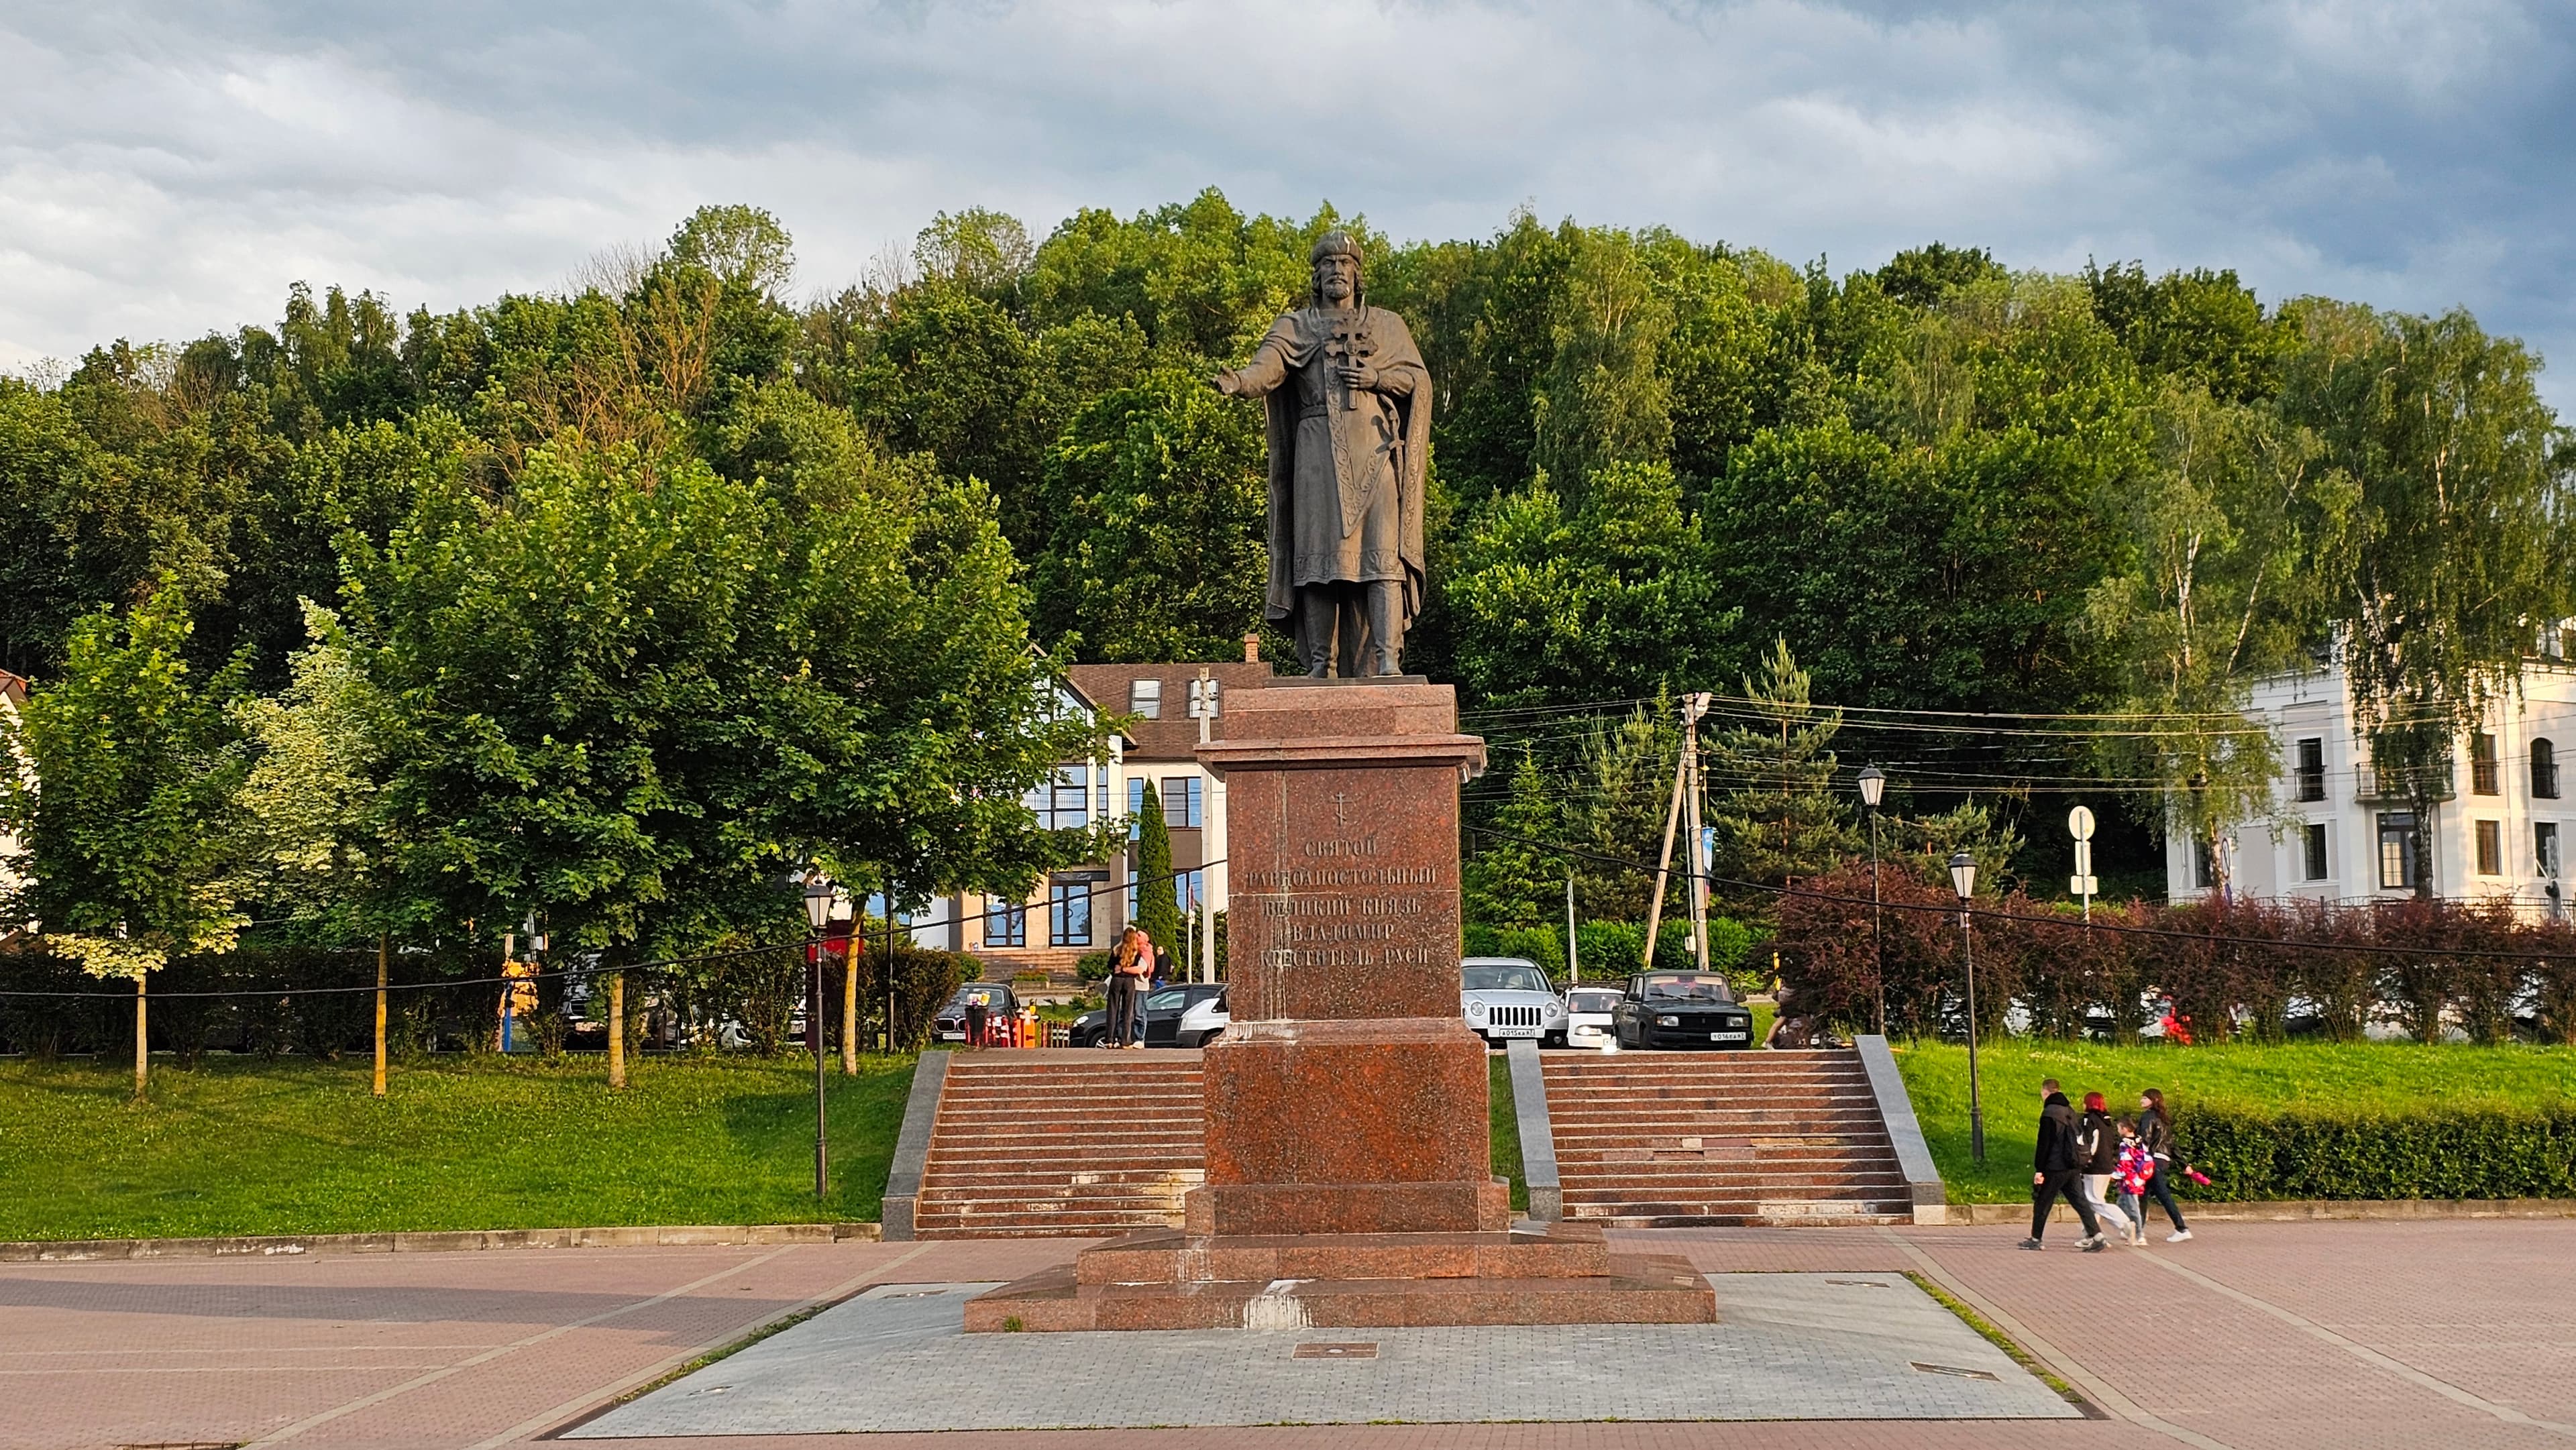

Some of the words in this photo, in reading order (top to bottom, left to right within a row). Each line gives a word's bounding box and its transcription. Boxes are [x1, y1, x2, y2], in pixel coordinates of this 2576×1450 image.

[1304, 836, 1377, 858] СВЯТОЙ
[1263, 896, 1350, 917] ВЕЛИКИЙ
[1362, 898, 1422, 916] КНЯЗЬ
[1292, 924, 1395, 942] ВЛАДИМИР
[1259, 949, 1375, 967] КРЕСТИТЕЛЬ
[1384, 948, 1430, 964] РУСИ
